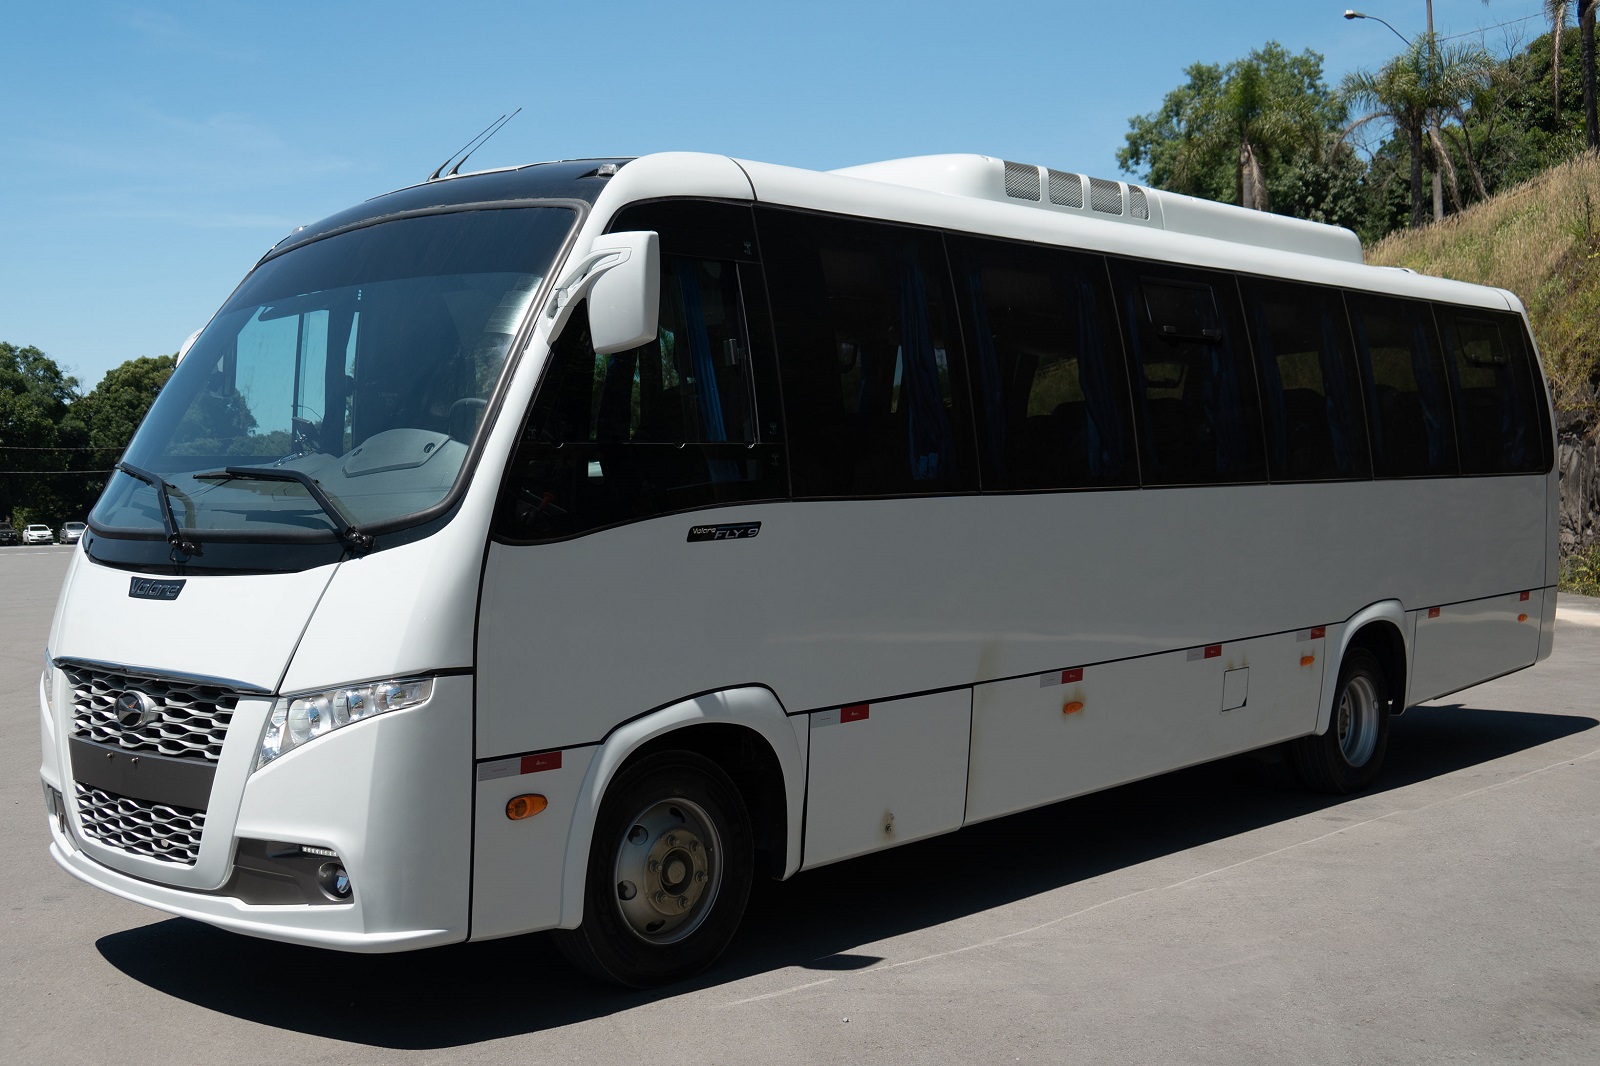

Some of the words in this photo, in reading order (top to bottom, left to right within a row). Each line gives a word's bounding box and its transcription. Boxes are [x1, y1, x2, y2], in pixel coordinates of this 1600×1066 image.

[714, 529, 744, 540] FLY
[747, 528, 758, 536] 9
[131, 579, 180, 597] Volare
